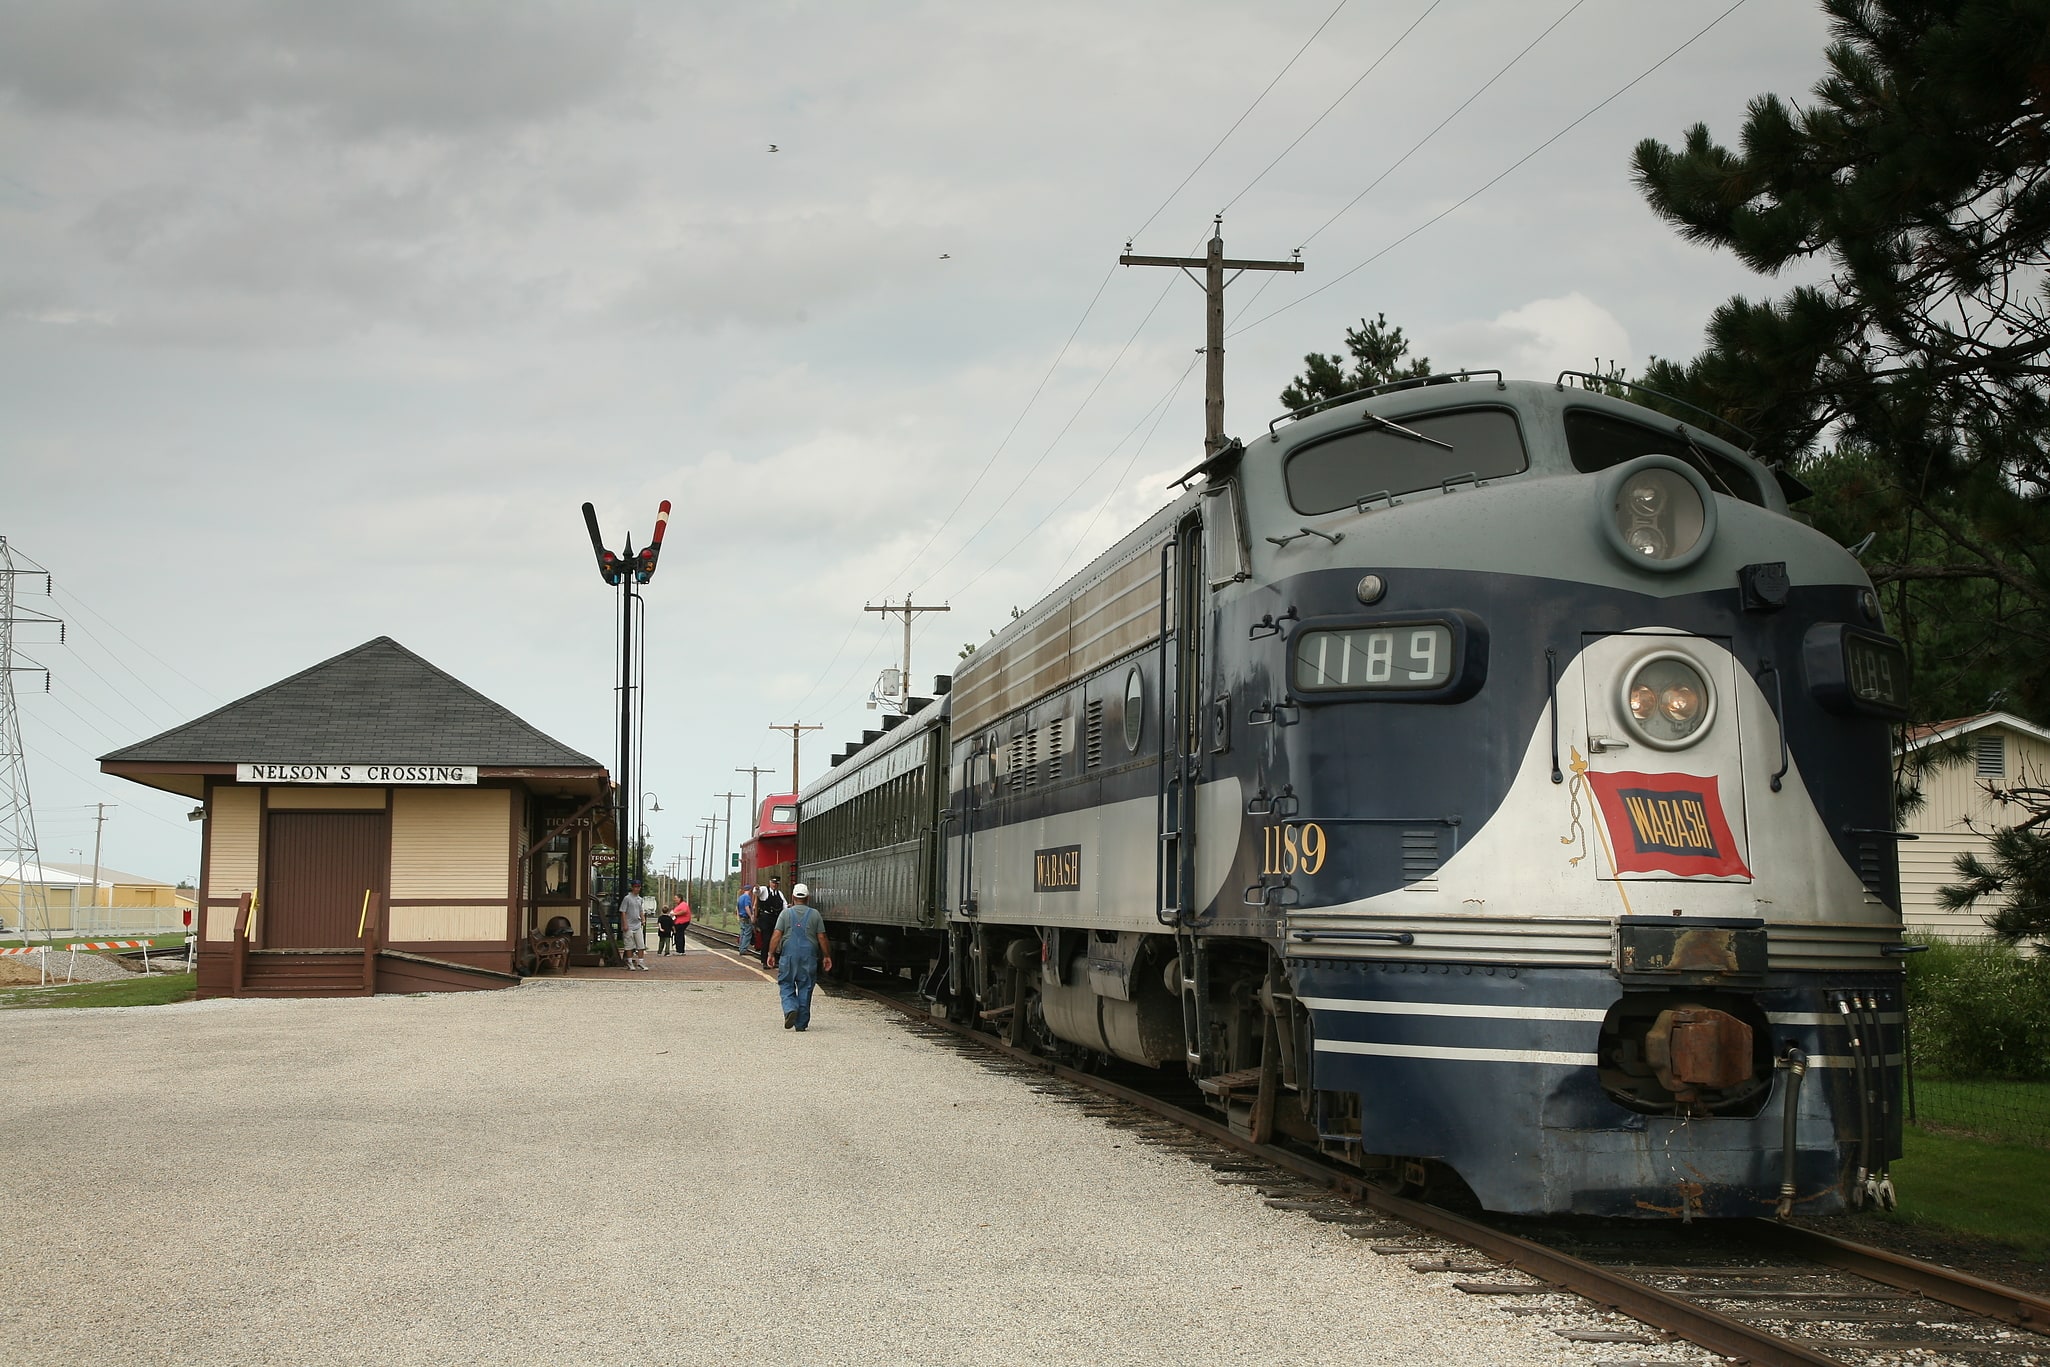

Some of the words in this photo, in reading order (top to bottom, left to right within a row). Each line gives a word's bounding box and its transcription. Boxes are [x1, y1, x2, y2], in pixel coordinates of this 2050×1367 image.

[1317, 630, 1437, 685] 1189
[252, 765, 351, 780] NELSON'S
[367, 766, 463, 781] CROSSING
[1263, 822, 1327, 875] 1189
[1626, 796, 1713, 850] WABASH
[1036, 851, 1078, 886] WABASH
